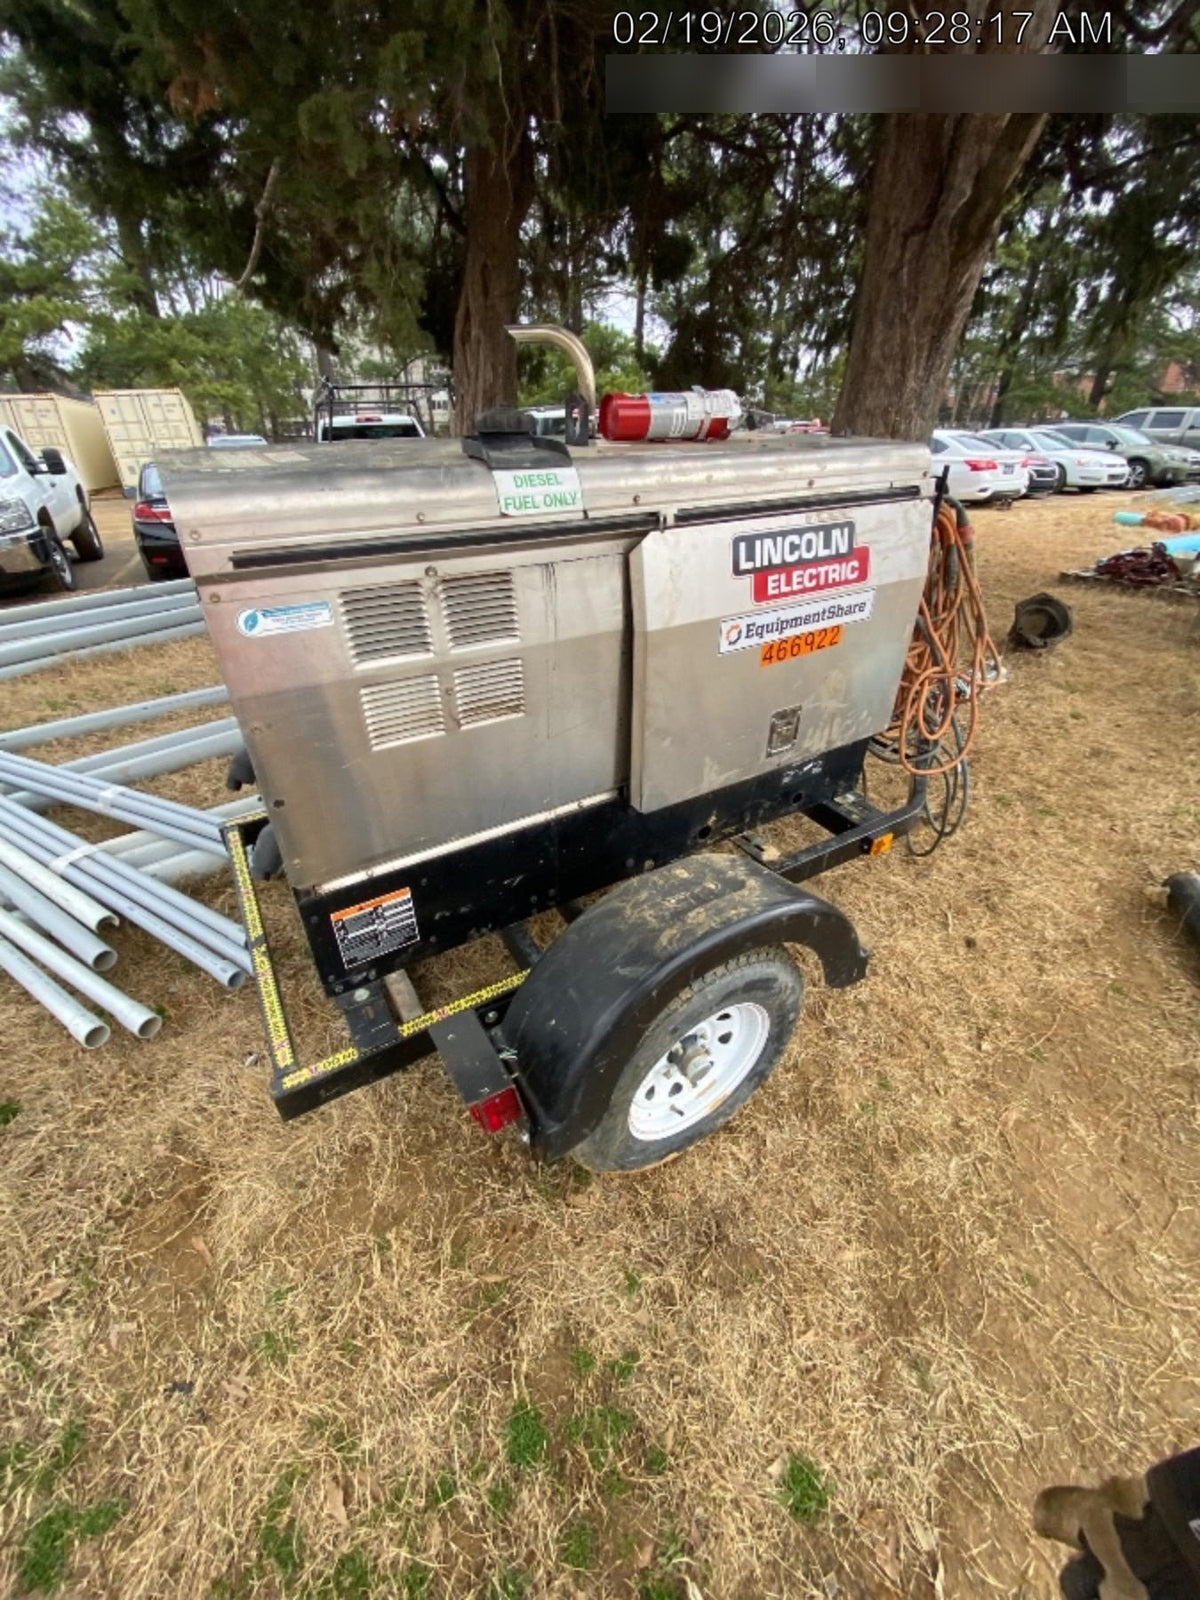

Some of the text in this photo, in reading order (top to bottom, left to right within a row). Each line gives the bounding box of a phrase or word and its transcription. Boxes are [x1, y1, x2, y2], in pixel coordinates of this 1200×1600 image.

[514, 473, 563, 488] DIESEL
[503, 491, 577, 511] FUEL ONLY
[738, 527, 849, 571] LINCOLN
[767, 561, 859, 596] ELECTRIC
[744, 601, 867, 640] EquipmentShare
[761, 624, 840, 664] 466922
